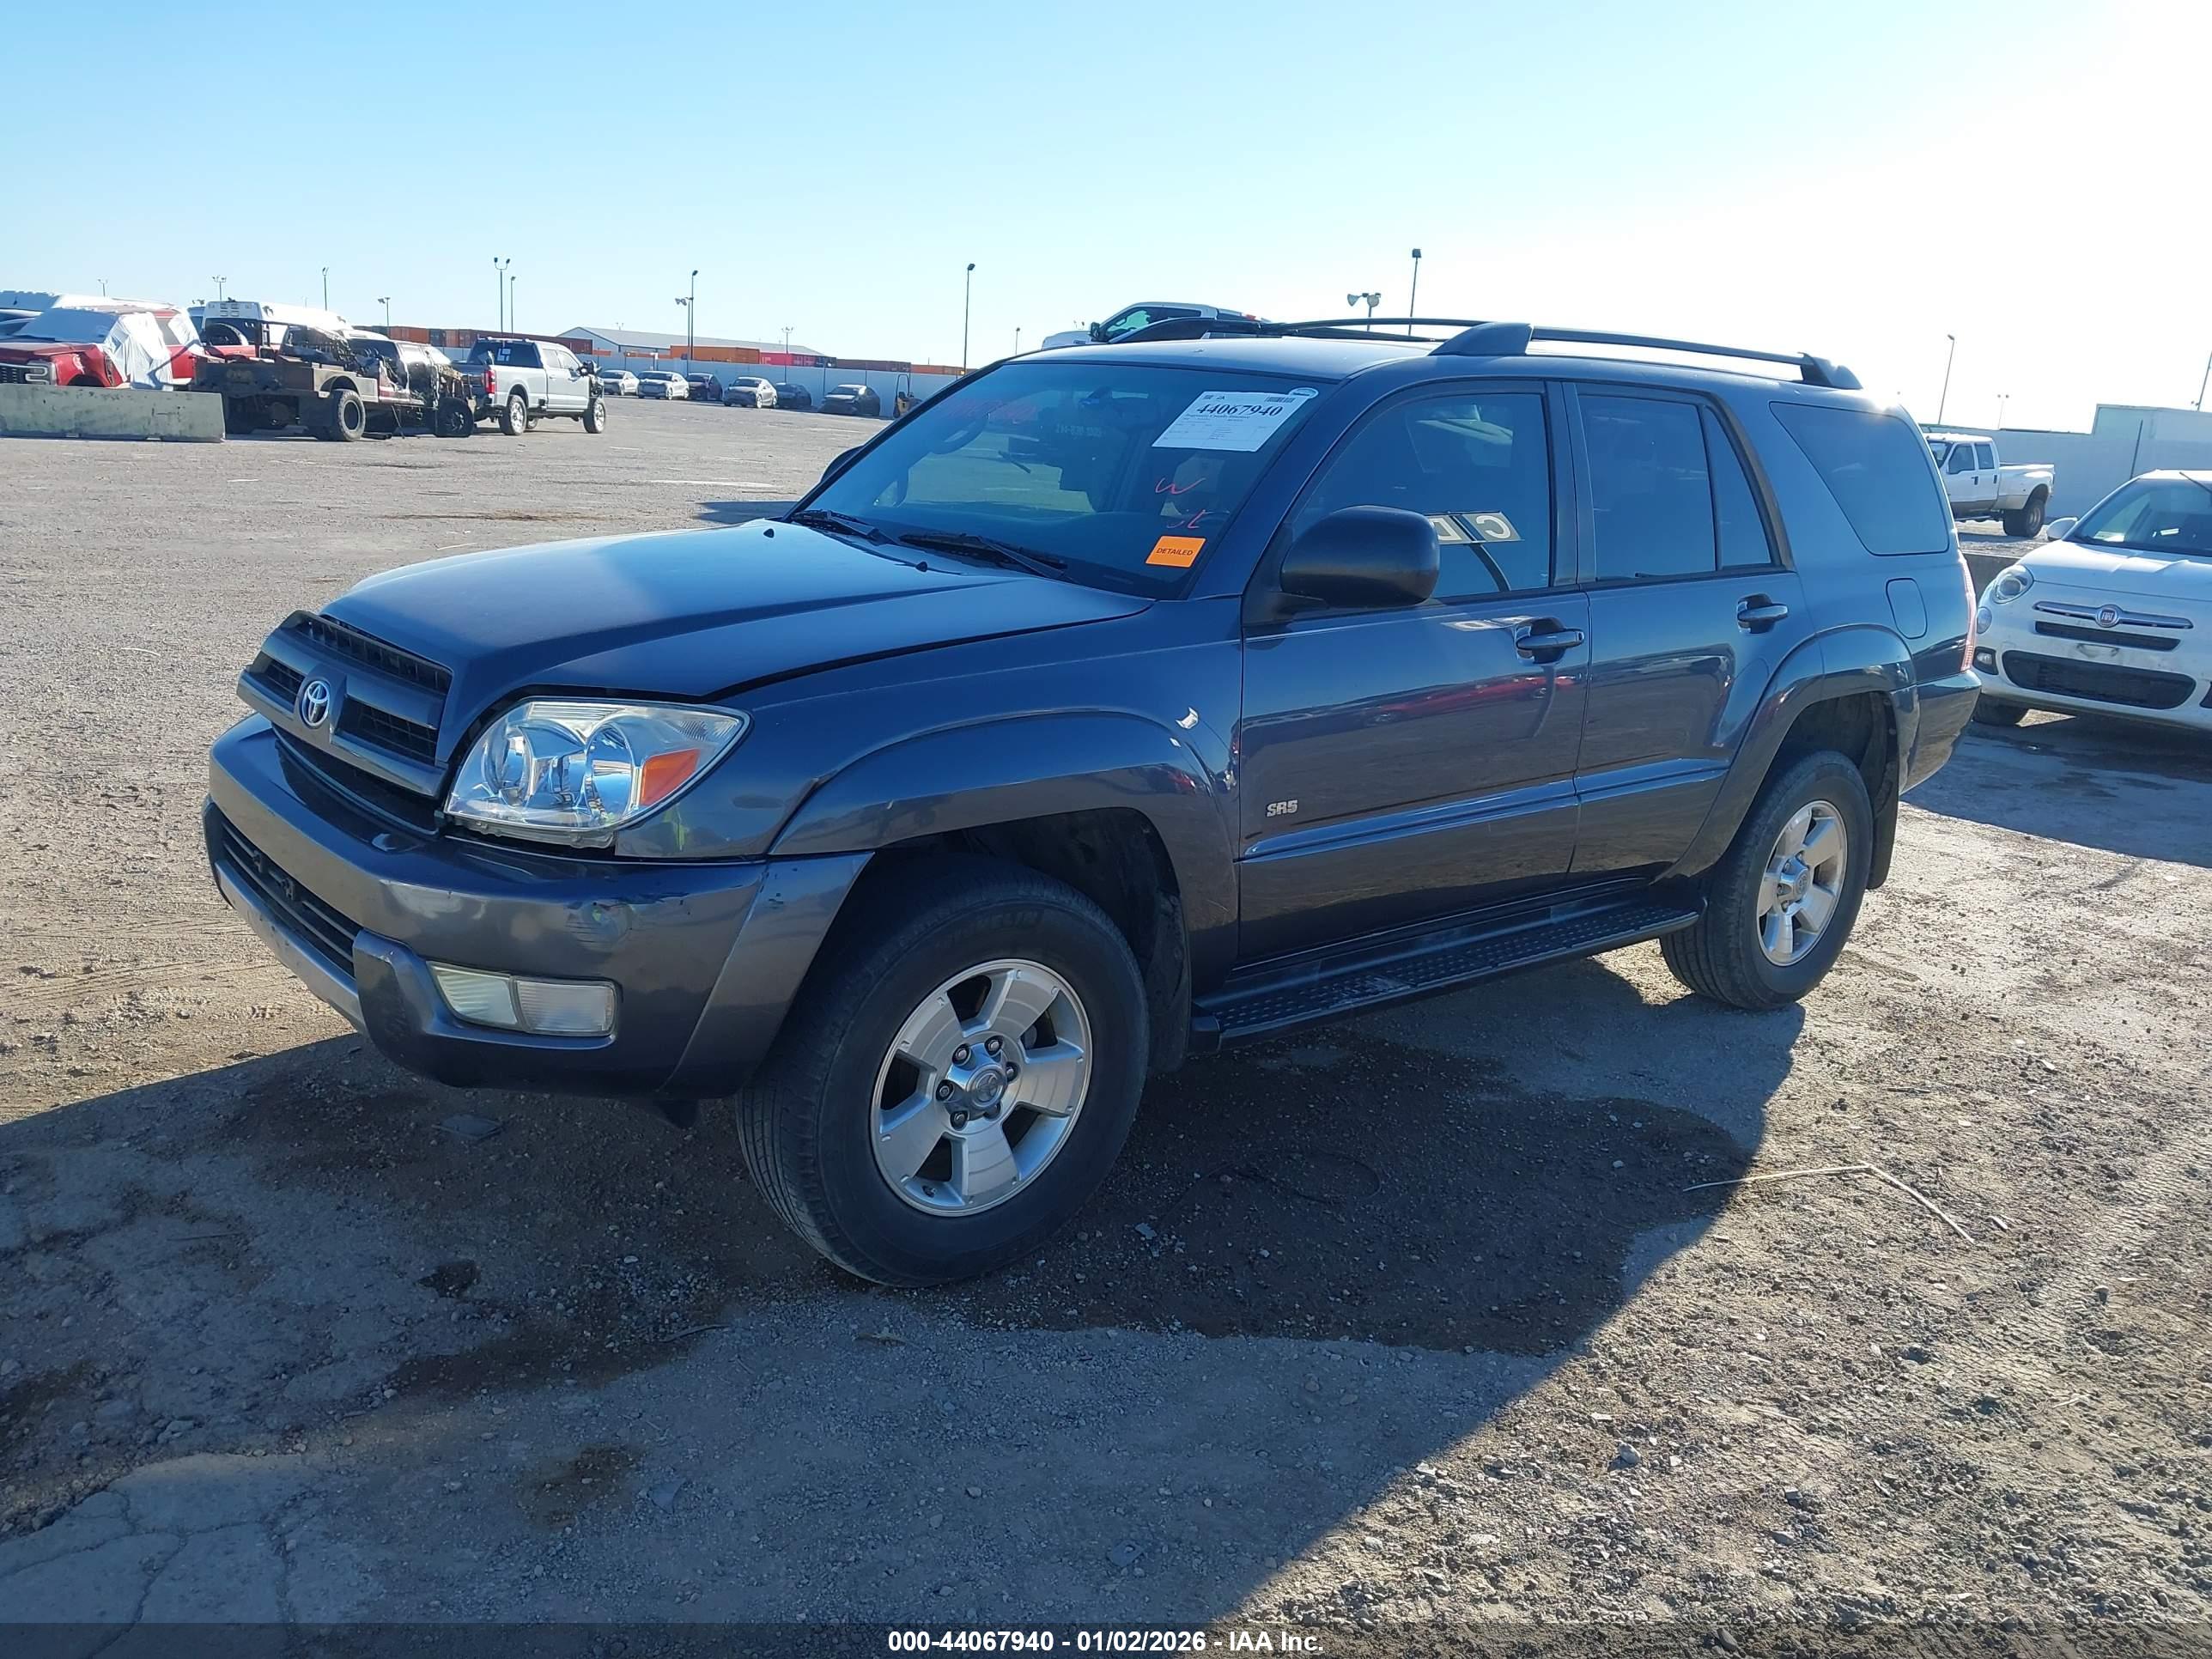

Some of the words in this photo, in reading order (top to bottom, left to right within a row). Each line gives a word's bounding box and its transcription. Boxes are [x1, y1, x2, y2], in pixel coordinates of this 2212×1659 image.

[1197, 404, 1284, 416] 44067940
[1156, 547, 1194, 556] DETAILED
[1266, 799, 1298, 817] SR5
